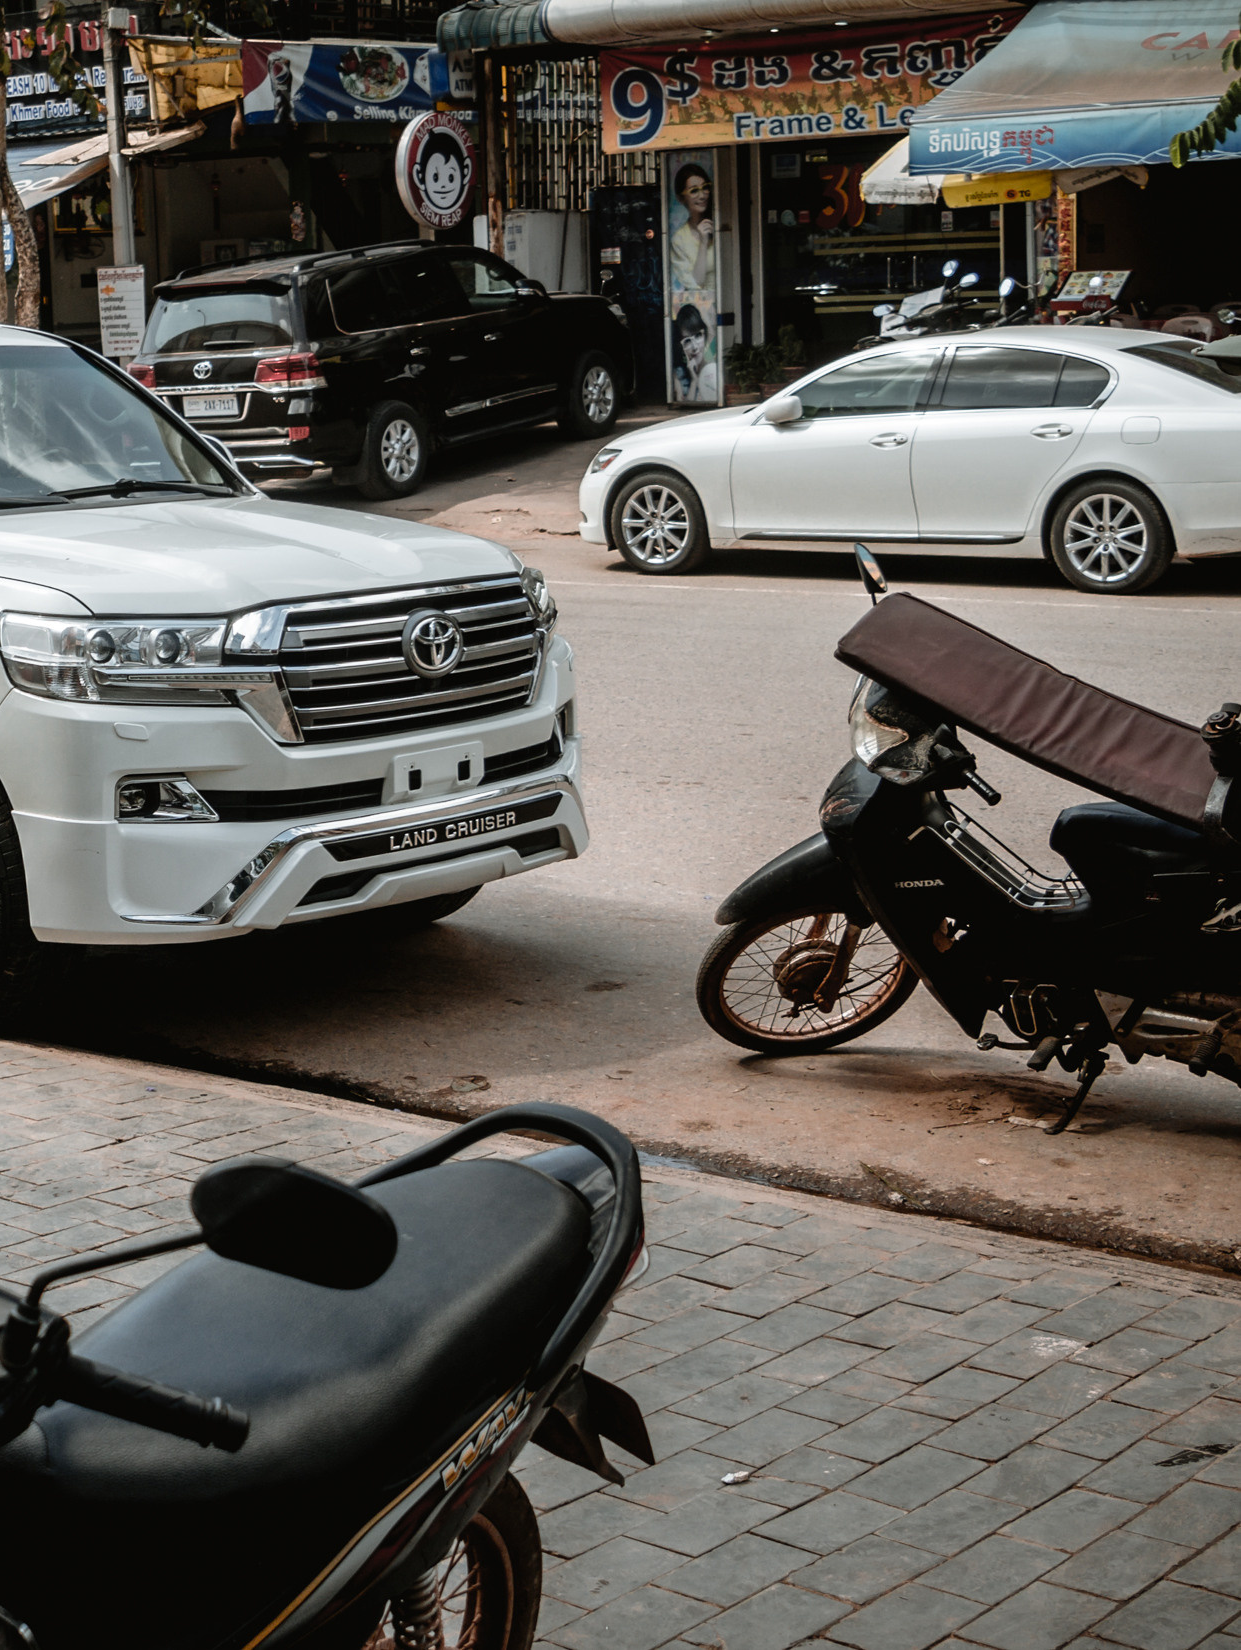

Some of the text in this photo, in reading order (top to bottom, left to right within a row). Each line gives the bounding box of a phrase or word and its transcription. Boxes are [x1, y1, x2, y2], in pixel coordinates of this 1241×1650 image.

[810, 48, 856, 85] &
[6, 75, 32, 97] EASH
[9, 103, 45, 122] Khmer
[45, 98, 72, 118] Food
[353, 105, 397, 122] Selling
[734, 112, 833, 139] Frame
[842, 105, 868, 132] &
[416, 115, 473, 147] MAD MONKEY
[420, 202, 462, 227] SIEM REAP
[389, 811, 516, 851] LAND CRUISER
[894, 879, 944, 888] HONDA
